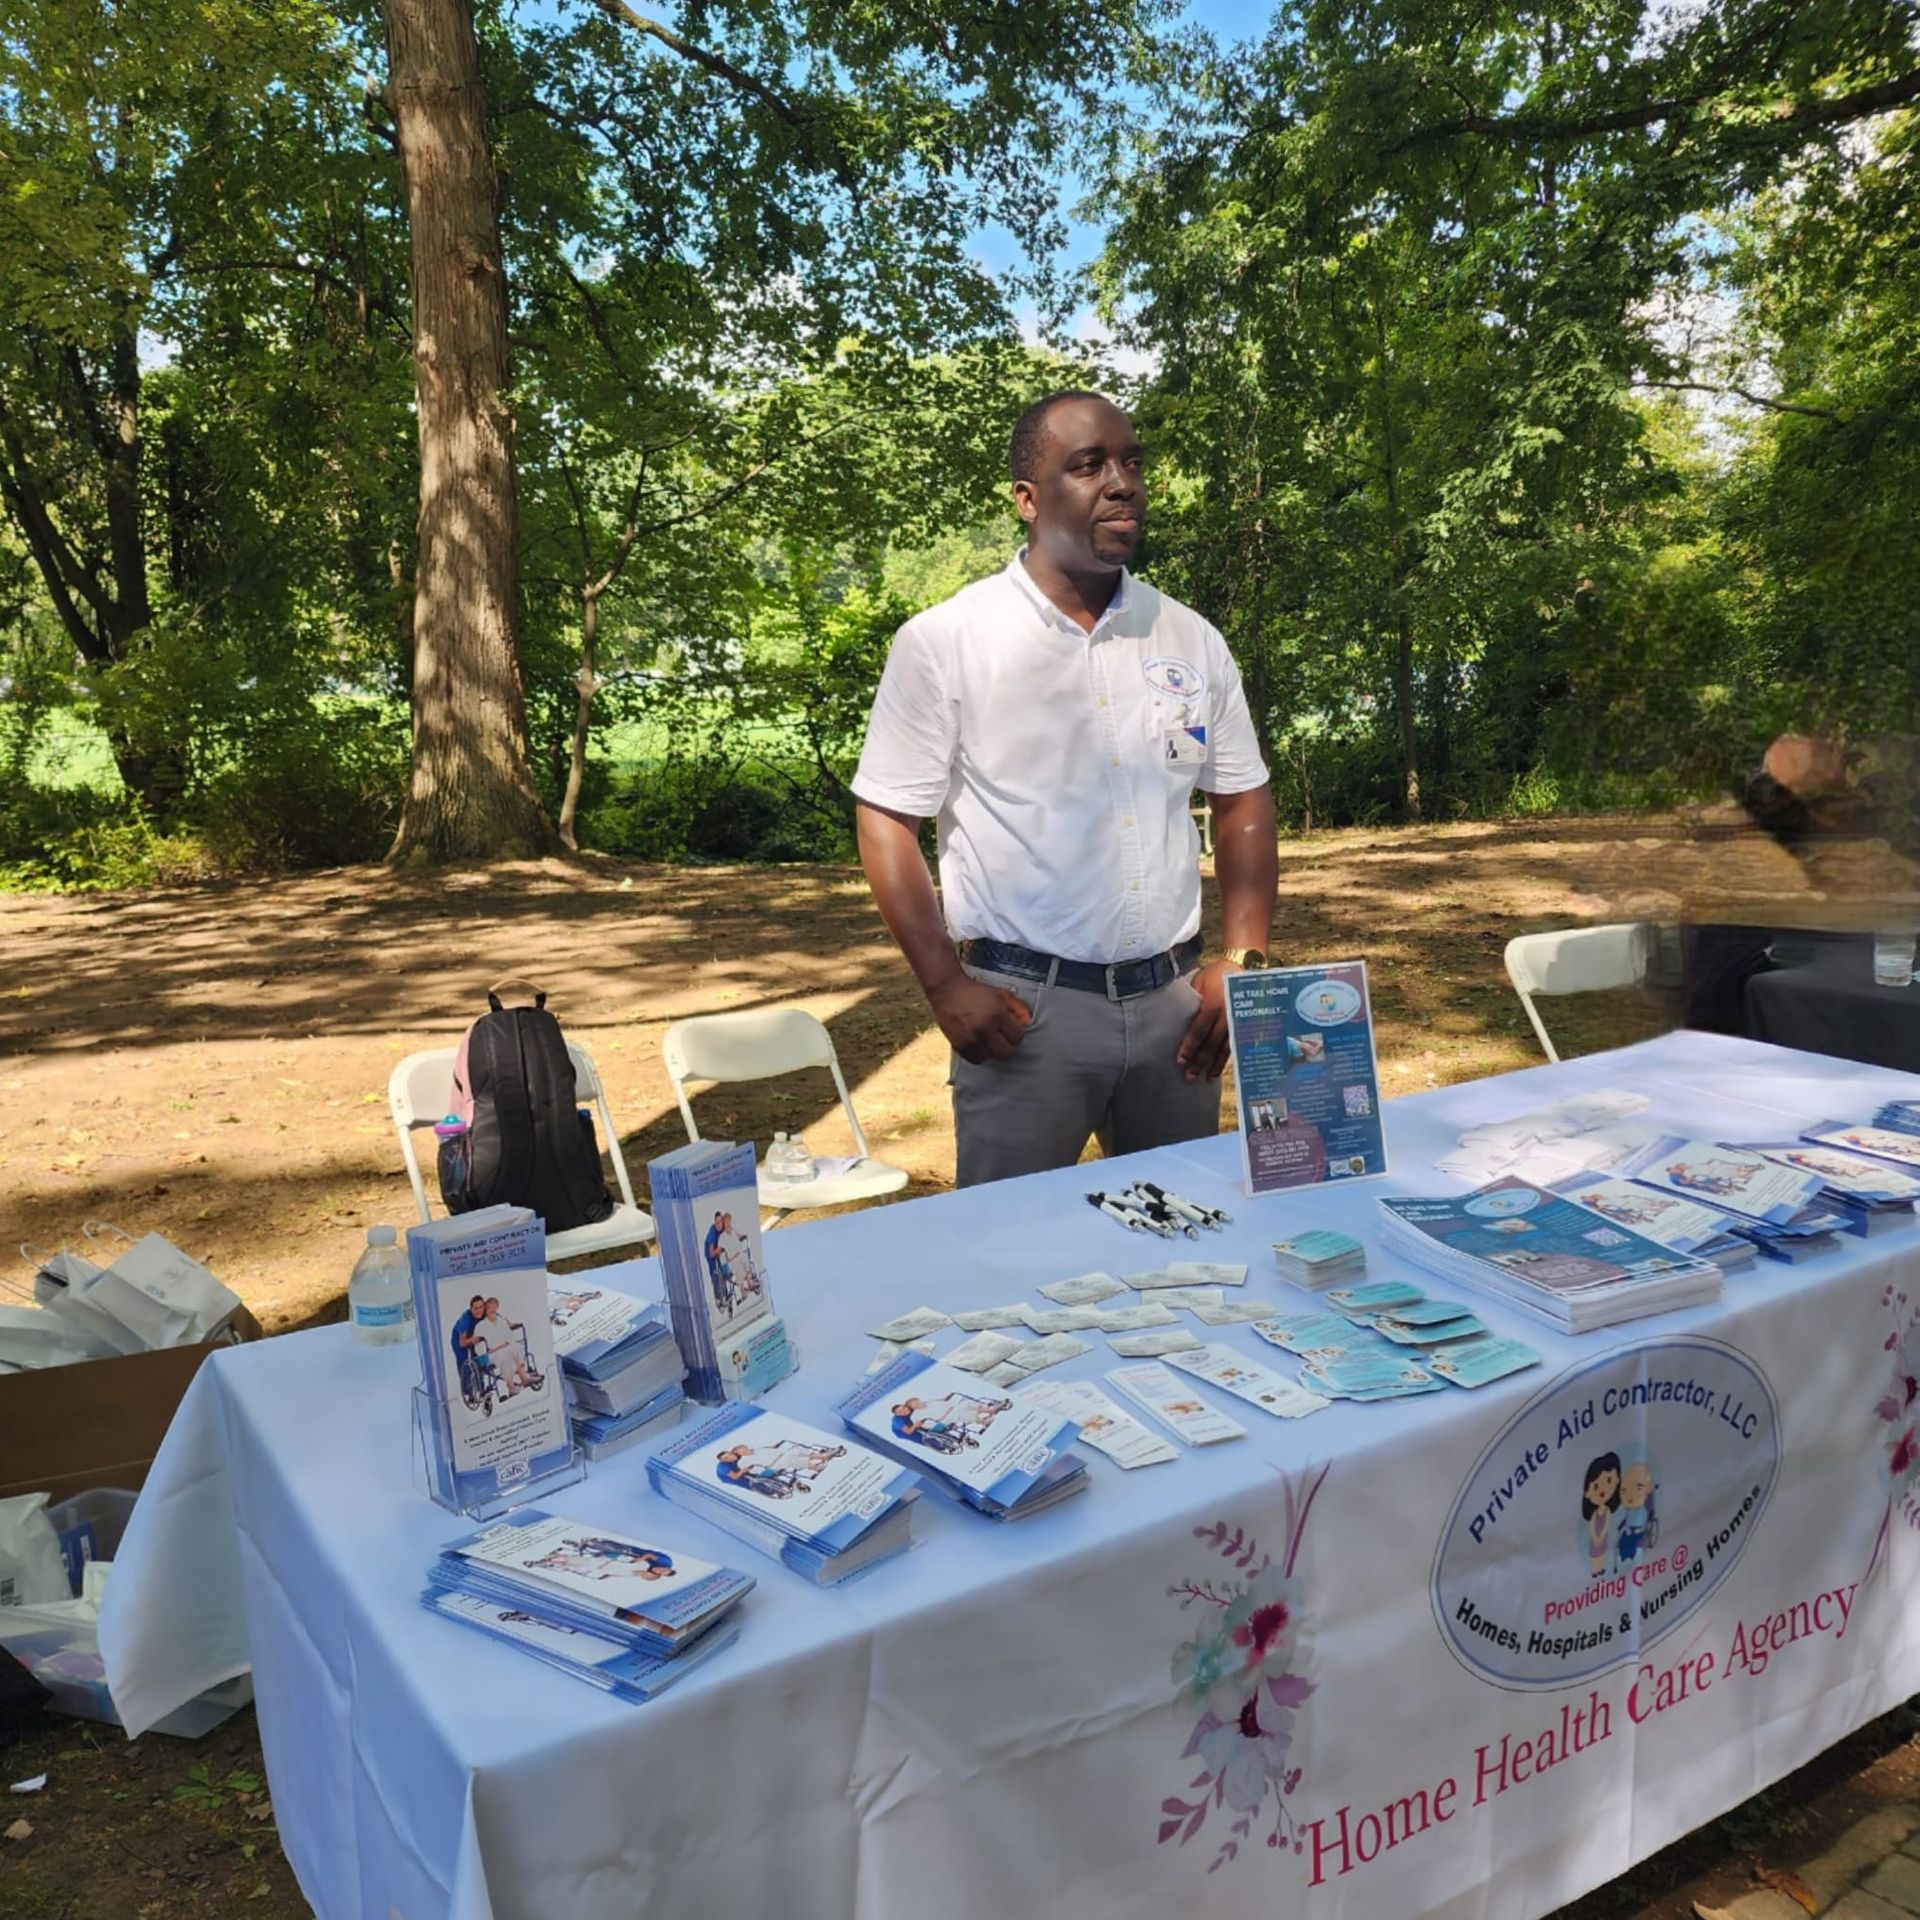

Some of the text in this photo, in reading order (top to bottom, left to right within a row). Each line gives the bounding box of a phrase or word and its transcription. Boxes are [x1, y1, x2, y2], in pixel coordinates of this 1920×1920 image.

[1266, 987, 1289, 996] HOME
[440, 1226, 541, 1256] PRIVATE AID CONTRACTOR
[1468, 1376, 1760, 1545] Private Aid Contractor, LLC
[1454, 1484, 1762, 1661] Homes, Hospitals & Nursing Homes
[1543, 1544, 1689, 1625] Providing Care @
[1306, 1582, 1858, 1888] Home Health Care Agency
